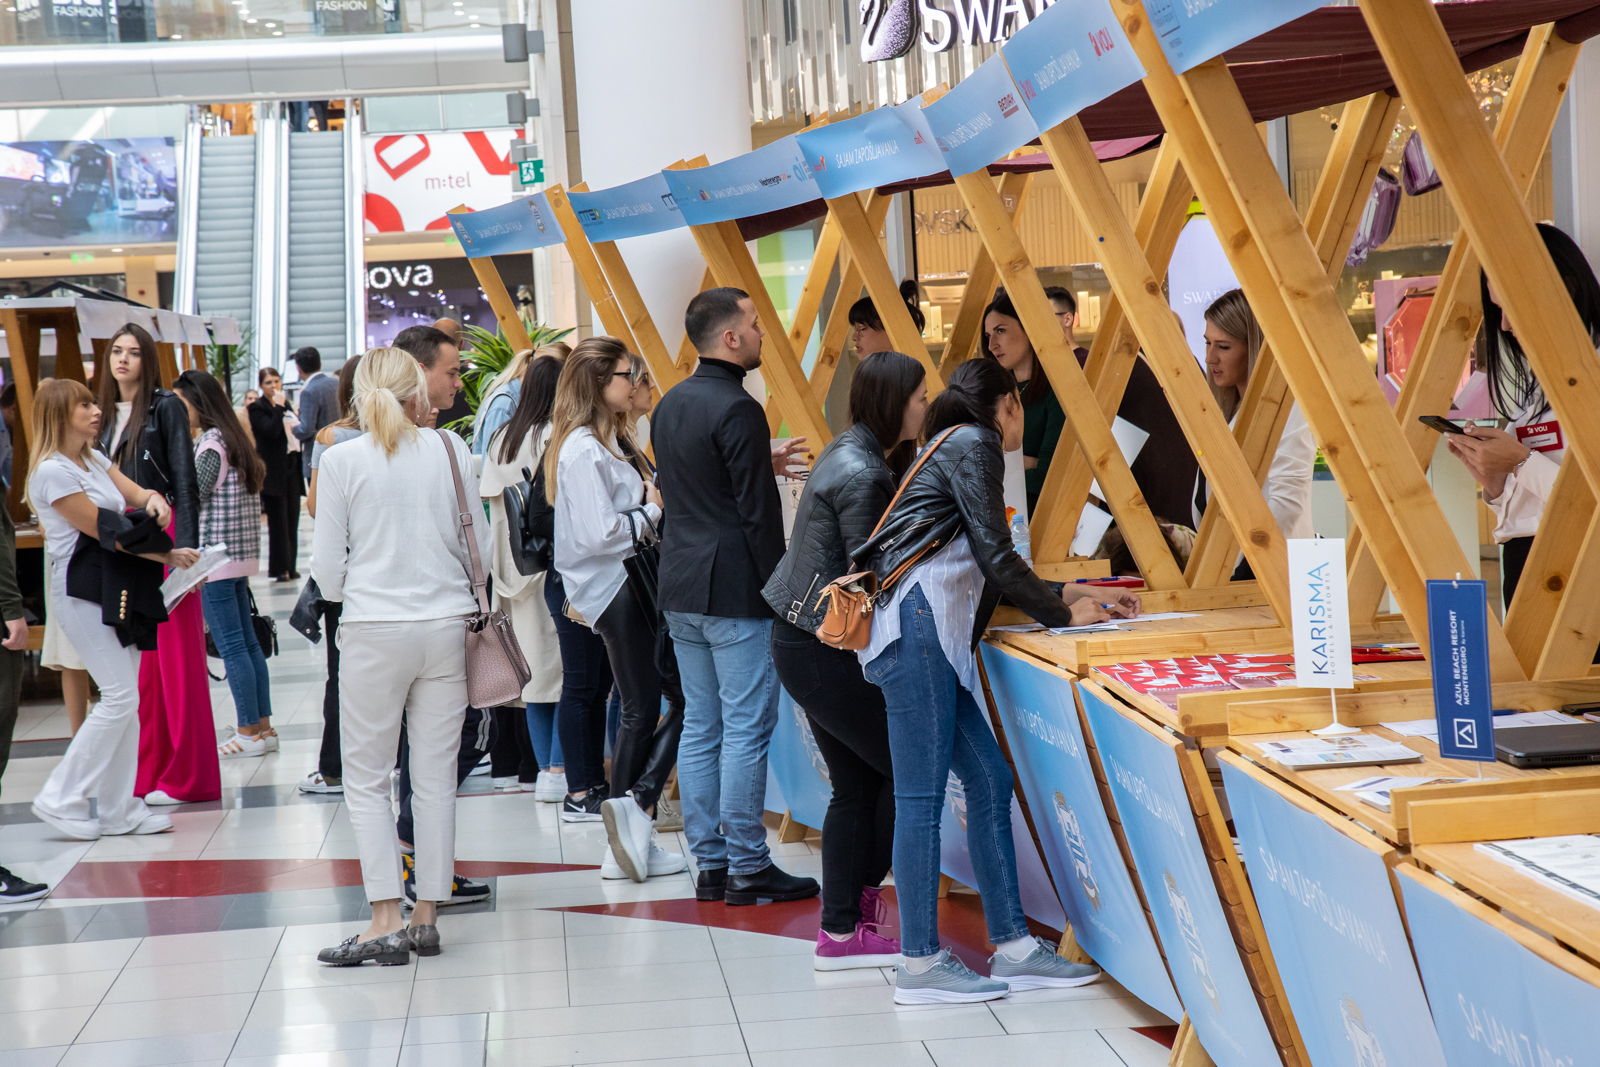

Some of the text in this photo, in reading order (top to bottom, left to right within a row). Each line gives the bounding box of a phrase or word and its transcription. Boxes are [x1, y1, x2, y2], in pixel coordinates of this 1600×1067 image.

[52, 5, 104, 17] FASHION
[316, 1, 367, 11] FASHION
[919, 0, 1058, 52] SWA
[836, 150, 856, 169] SAJAM
[854, 139, 900, 164] ZAPOŠLJAVANJA
[425, 171, 472, 190] m:tel
[365, 264, 434, 289] ova
[1307, 562, 1330, 675] KARISMA
[1325, 572, 1333, 619] RESORTS
[1449, 609, 1463, 706] AZUL BEACH RESORT
[1460, 646, 1470, 706] MONTENEGRO
[1259, 846, 1393, 971] SAJAM ZAPOŠLJAVANJA
[1458, 992, 1527, 1067] SAJAM
